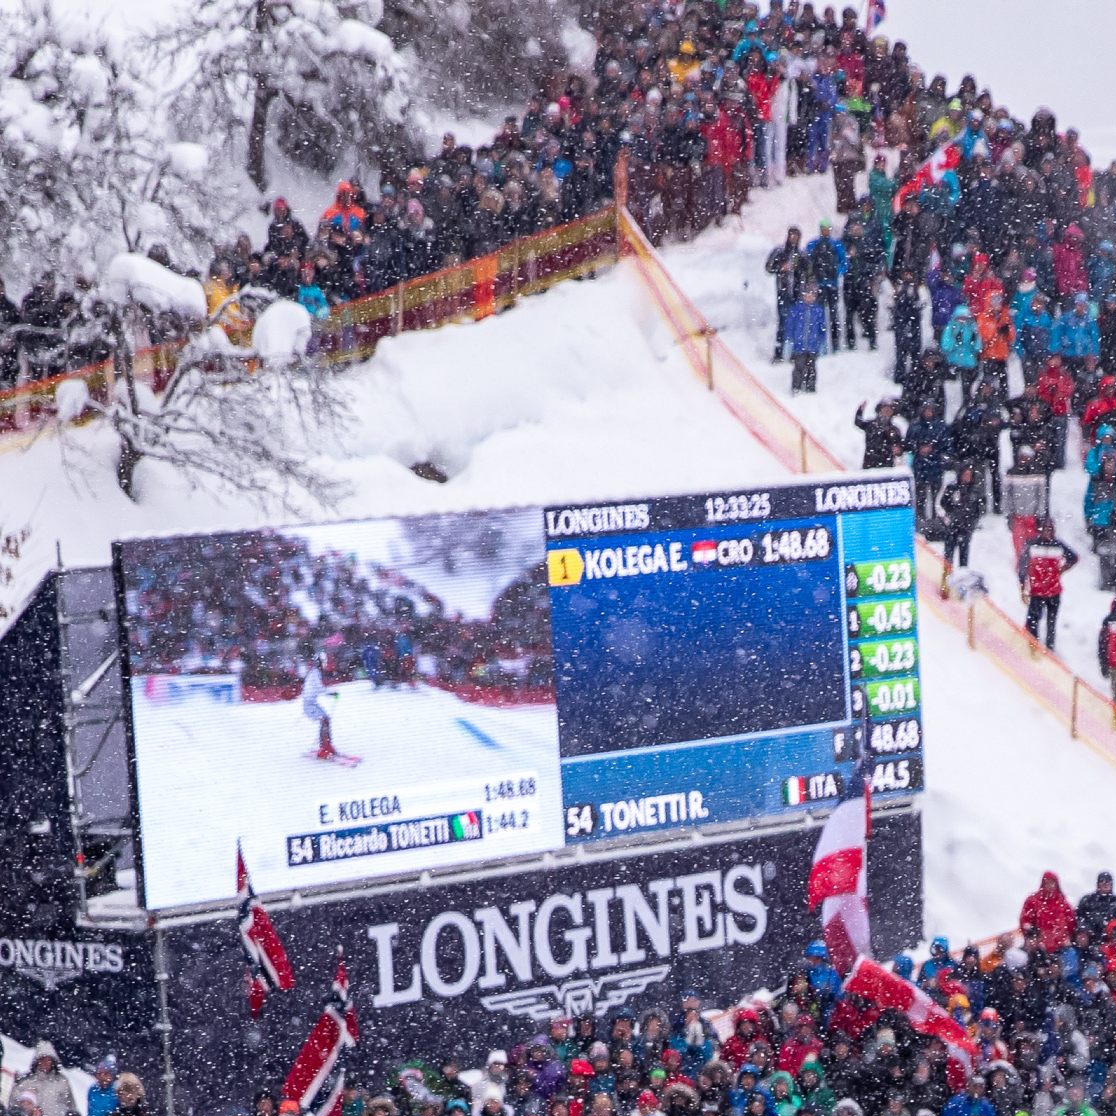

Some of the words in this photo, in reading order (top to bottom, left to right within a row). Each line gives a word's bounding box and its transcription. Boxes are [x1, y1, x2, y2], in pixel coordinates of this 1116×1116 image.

[814, 481, 911, 511] LONGINES
[546, 504, 651, 535] LONGINES
[558, 556, 570, 579] 1
[585, 546, 667, 579] KOLEGA
[668, 542, 688, 571] E.
[716, 539, 753, 566] CRO
[762, 529, 830, 563] 1:48.68
[866, 562, 911, 592] -0.23
[848, 610, 859, 632] 1
[867, 600, 913, 633] -0.45
[850, 649, 862, 672] 2
[869, 641, 916, 673] -0.23
[871, 682, 917, 714] -0.01
[868, 719, 921, 754] 48.68
[339, 796, 402, 822] KOLEGA
[566, 808, 593, 836] 54
[600, 795, 687, 831] TONETTI
[808, 773, 839, 799] ITA
[289, 837, 314, 864] 54
[319, 827, 388, 860] Riccardo
[388, 816, 450, 850] TONETTI
[485, 810, 530, 833] 1:44.2
[368, 863, 768, 1008] LONGINES
